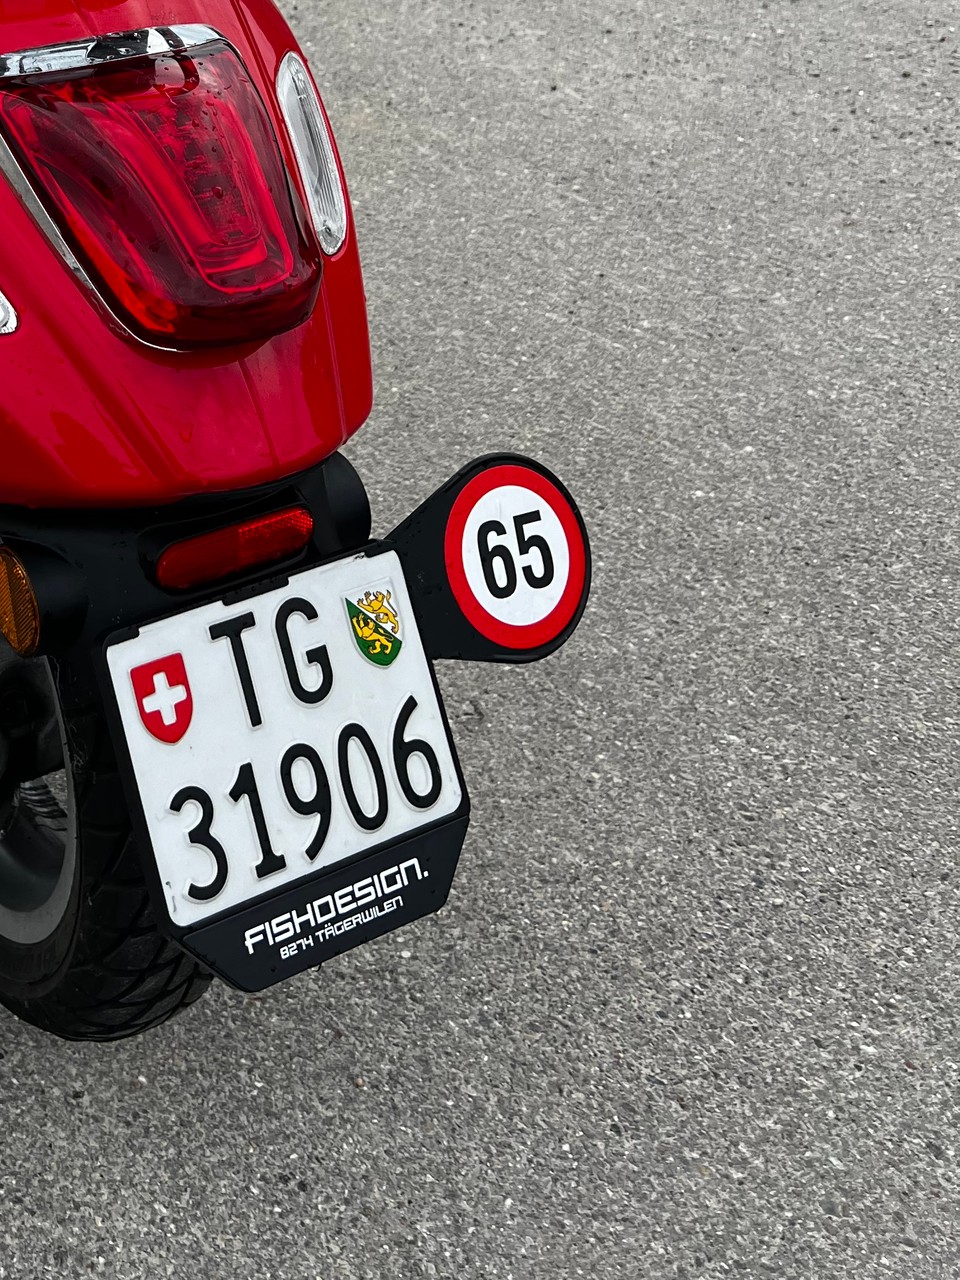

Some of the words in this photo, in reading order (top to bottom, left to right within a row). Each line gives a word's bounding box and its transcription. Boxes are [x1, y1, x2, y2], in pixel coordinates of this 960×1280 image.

[477, 509, 556, 600] 65
[208, 597, 334, 728] TG
[169, 694, 443, 902] 31906
[279, 934, 314, 960] 8274
[315, 895, 404, 943] TÄGERWILEN
